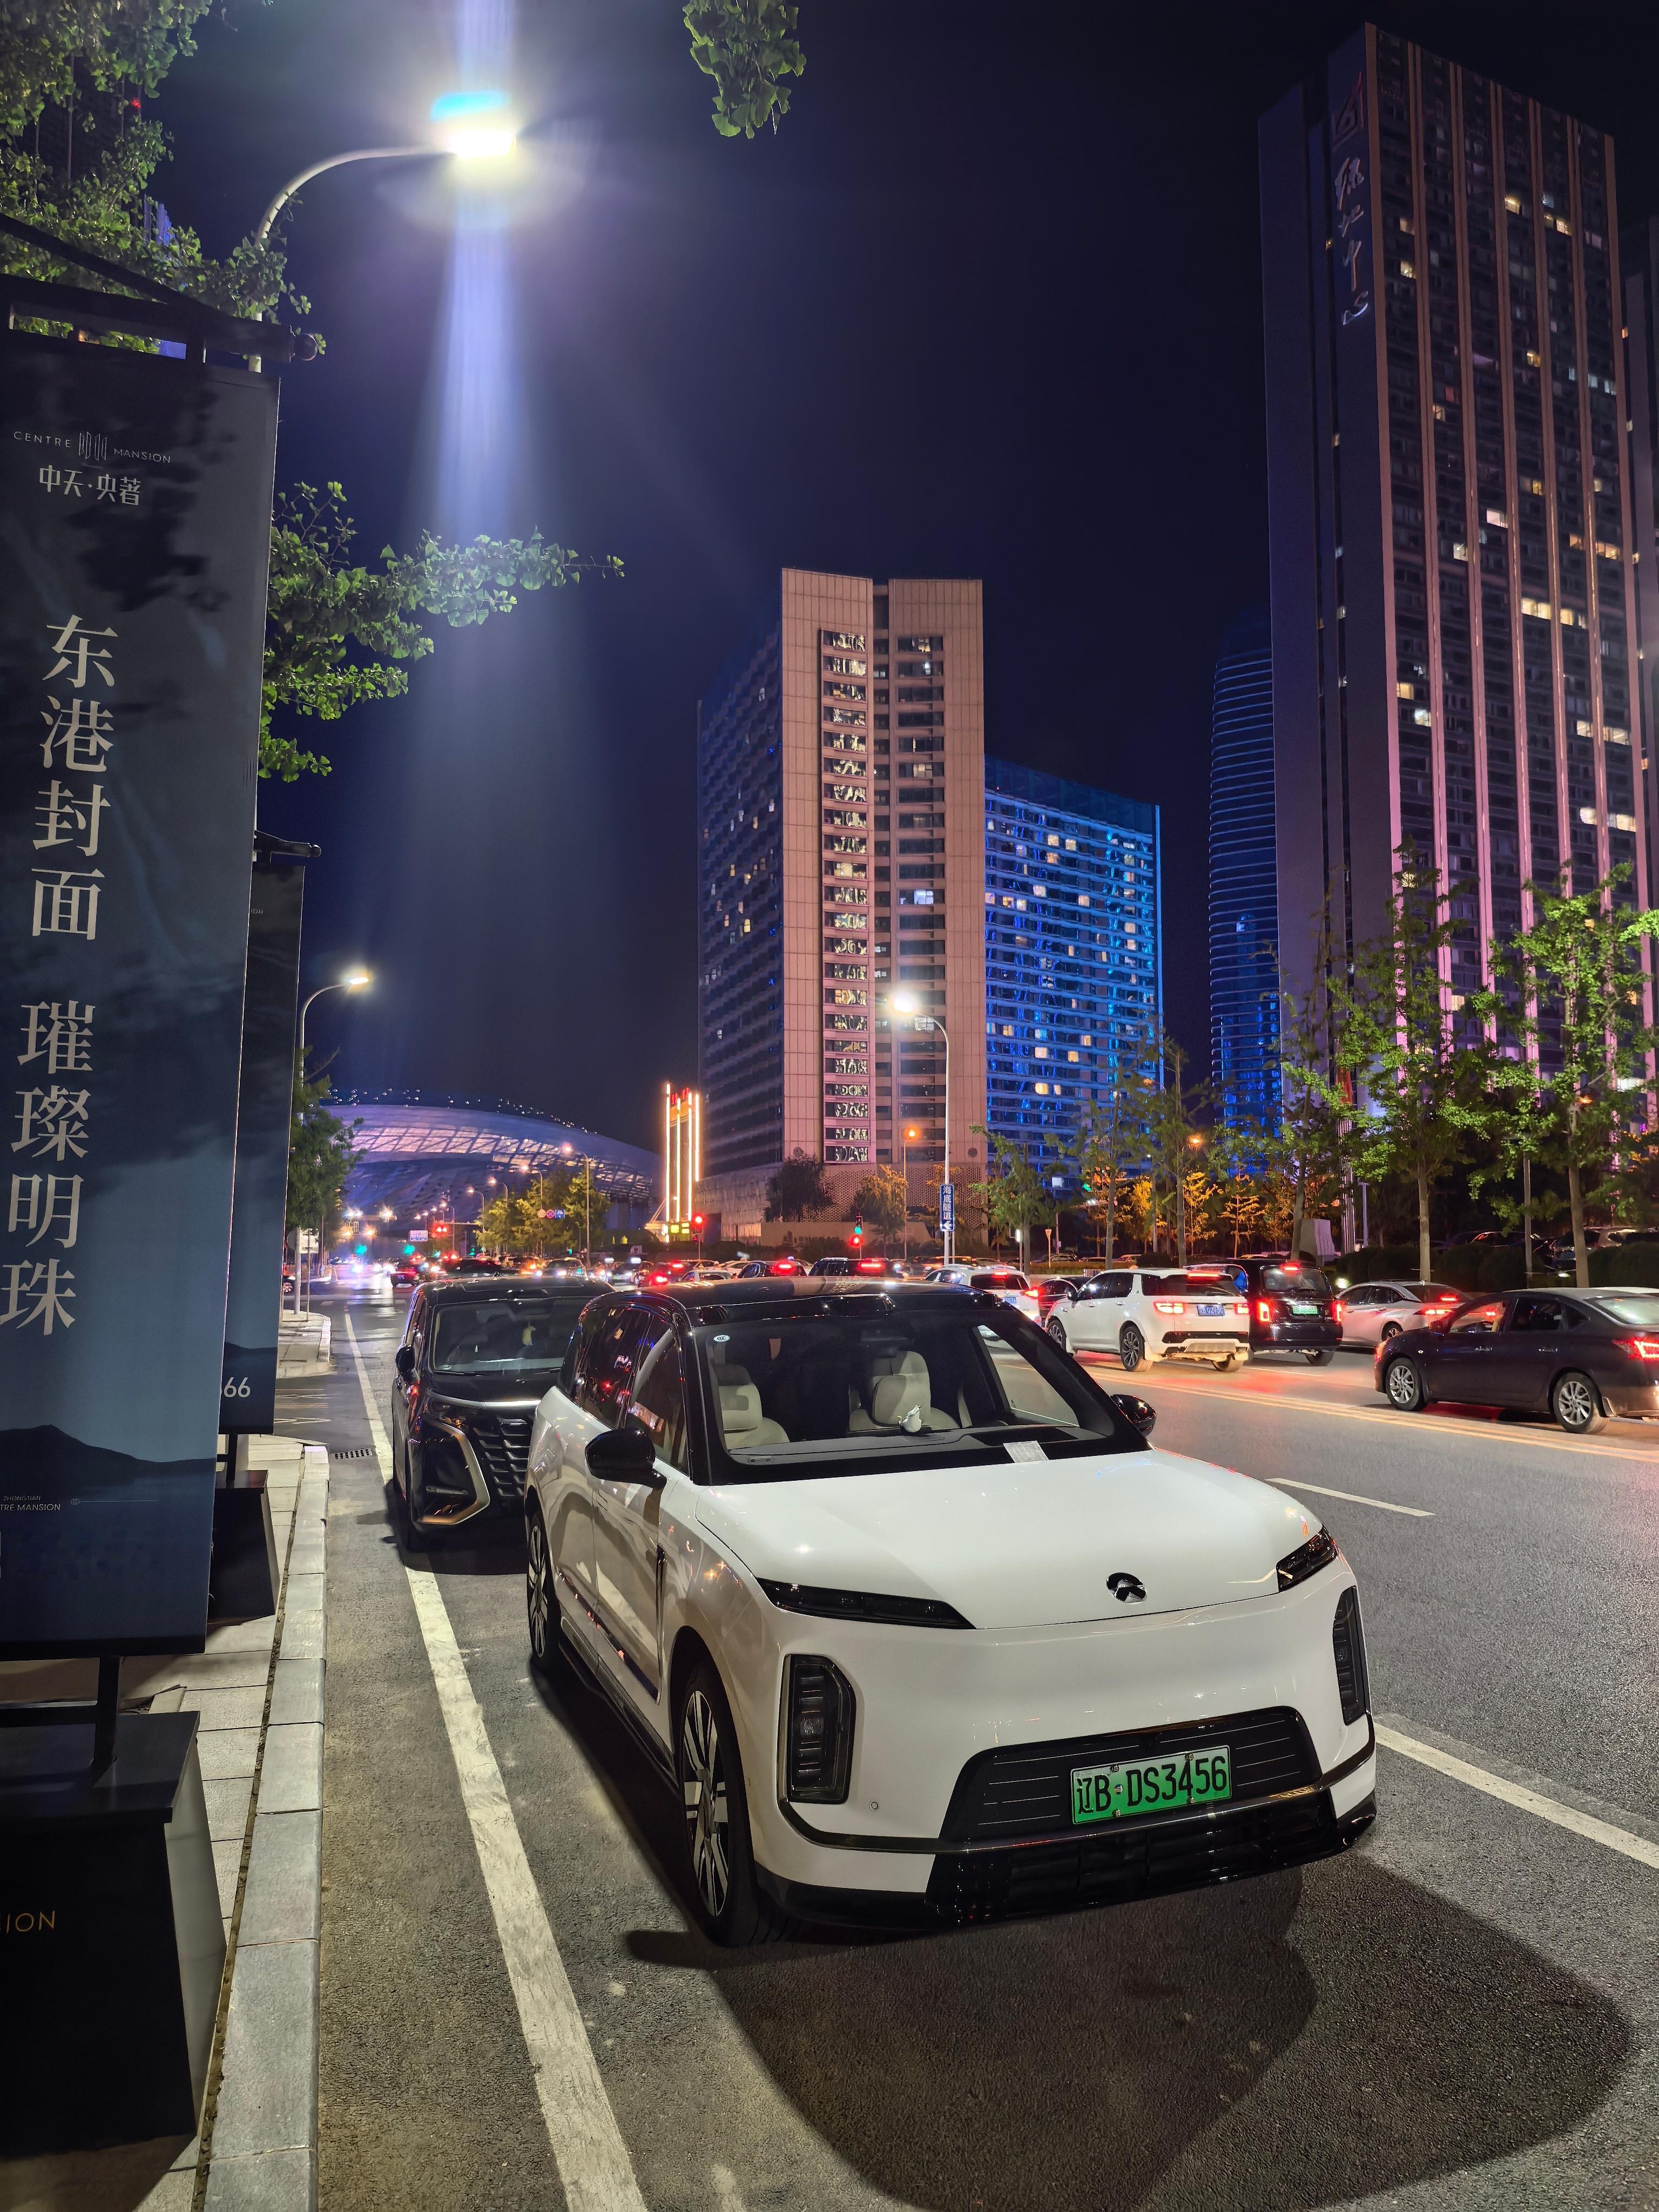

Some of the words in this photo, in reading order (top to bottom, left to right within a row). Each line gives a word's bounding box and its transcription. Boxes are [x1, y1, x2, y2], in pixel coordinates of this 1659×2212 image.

[14, 431, 71, 448] CENTRE
[113, 448, 171, 463] MANSION
[31, 614, 118, 940] 东港封面
[0, 1000, 96, 1336] 璀璨明珠
